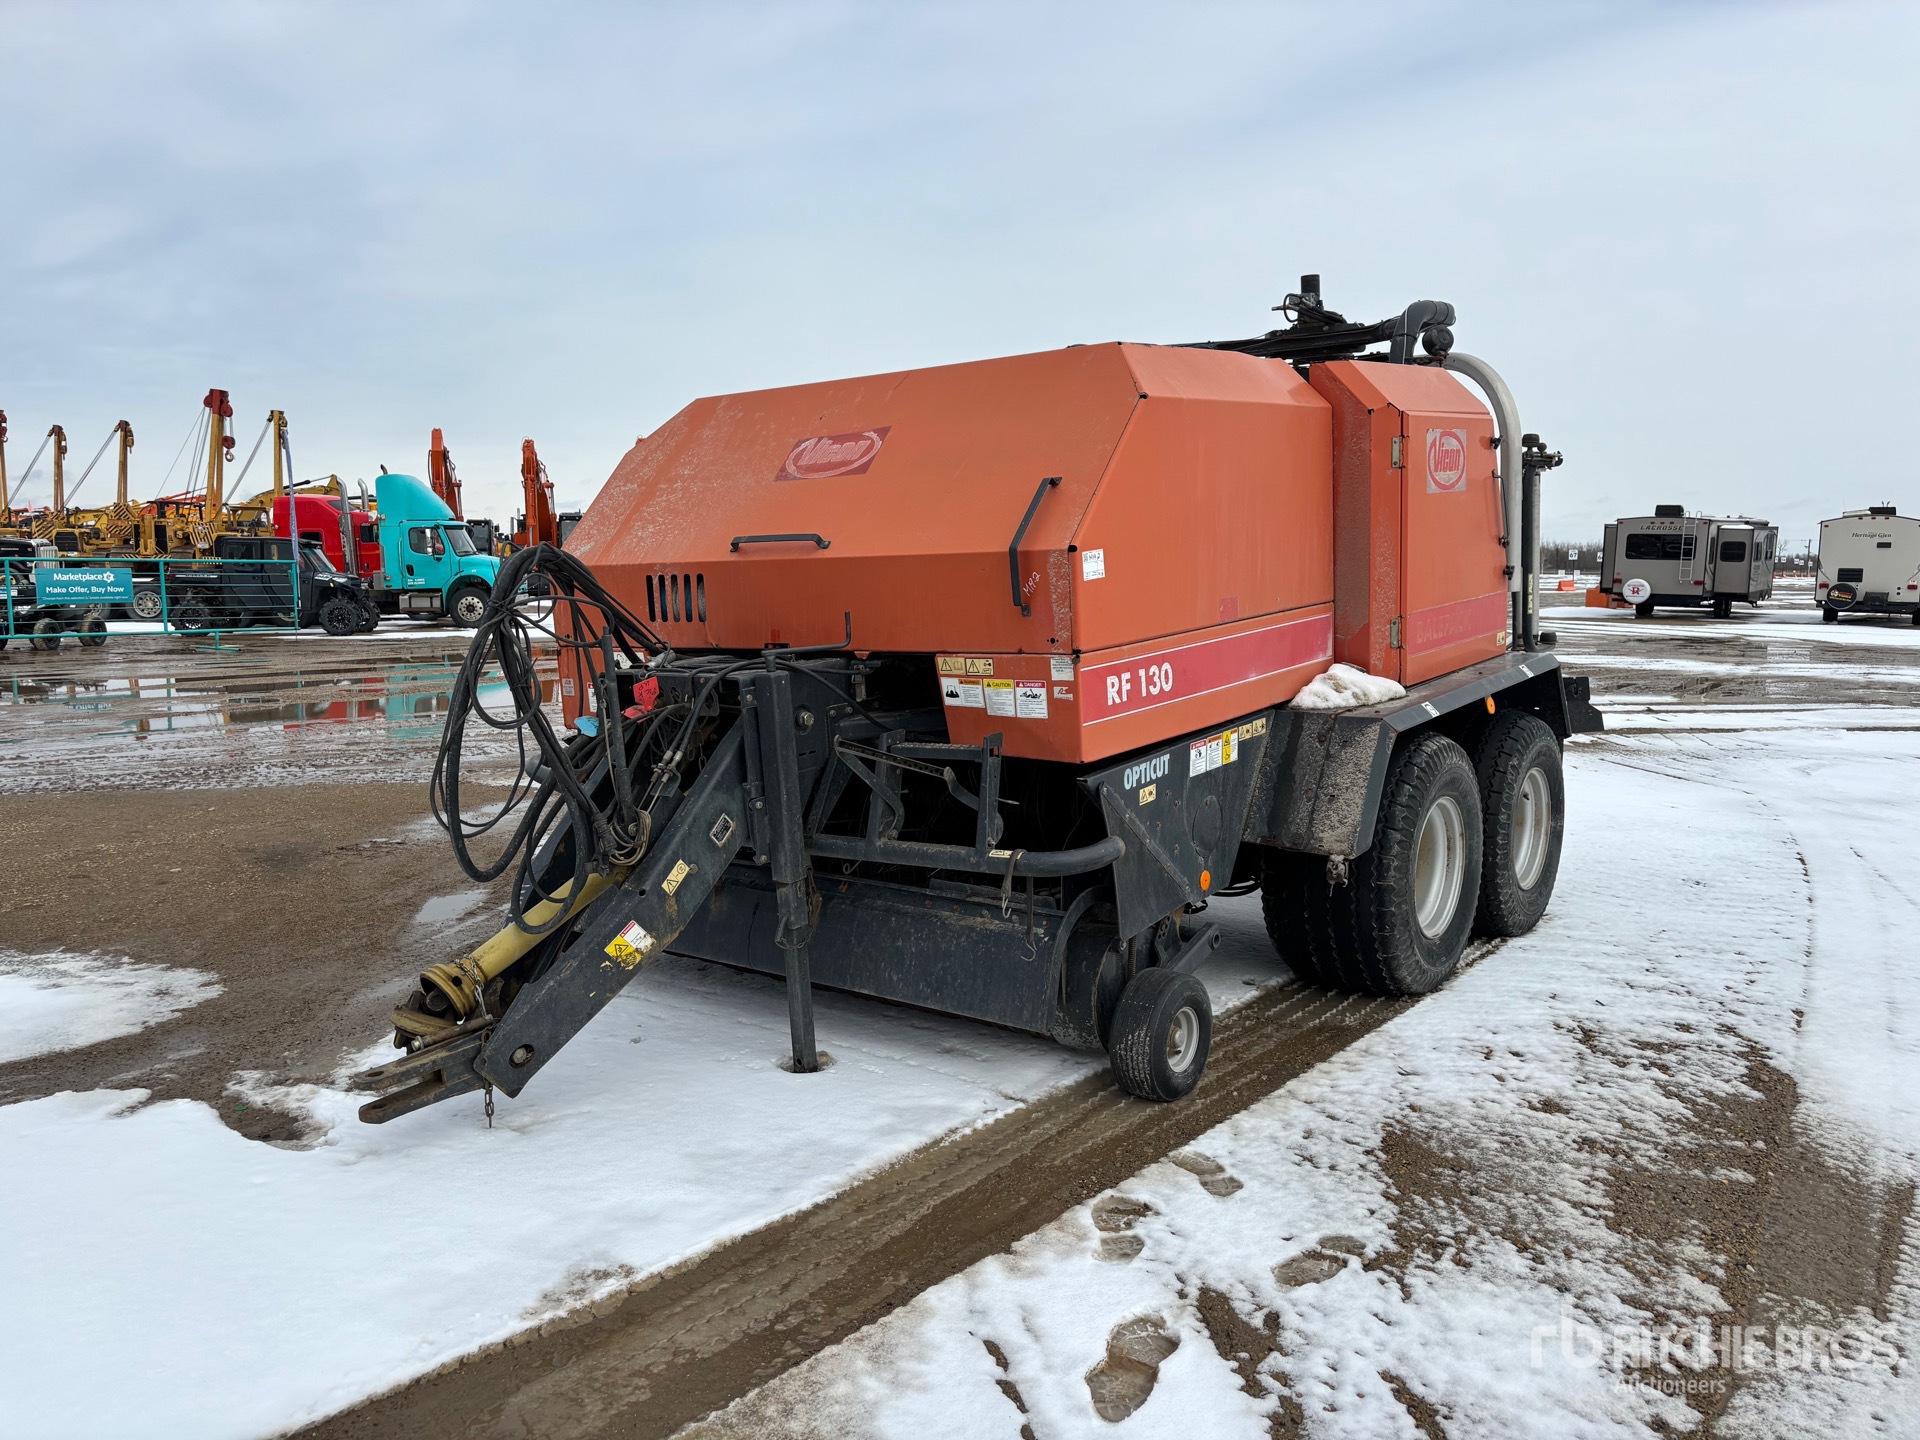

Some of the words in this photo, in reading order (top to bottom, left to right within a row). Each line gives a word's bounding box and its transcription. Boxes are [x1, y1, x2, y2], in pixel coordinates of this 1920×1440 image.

[797, 436, 871, 466] Vicon
[53, 572, 103, 582] Marketplace
[68, 586, 90, 594] Offer,
[91, 586, 105, 594] Buy
[1106, 671, 1132, 706] RF
[1138, 662, 1173, 697] 130
[1124, 754, 1170, 790] OPTICUT
